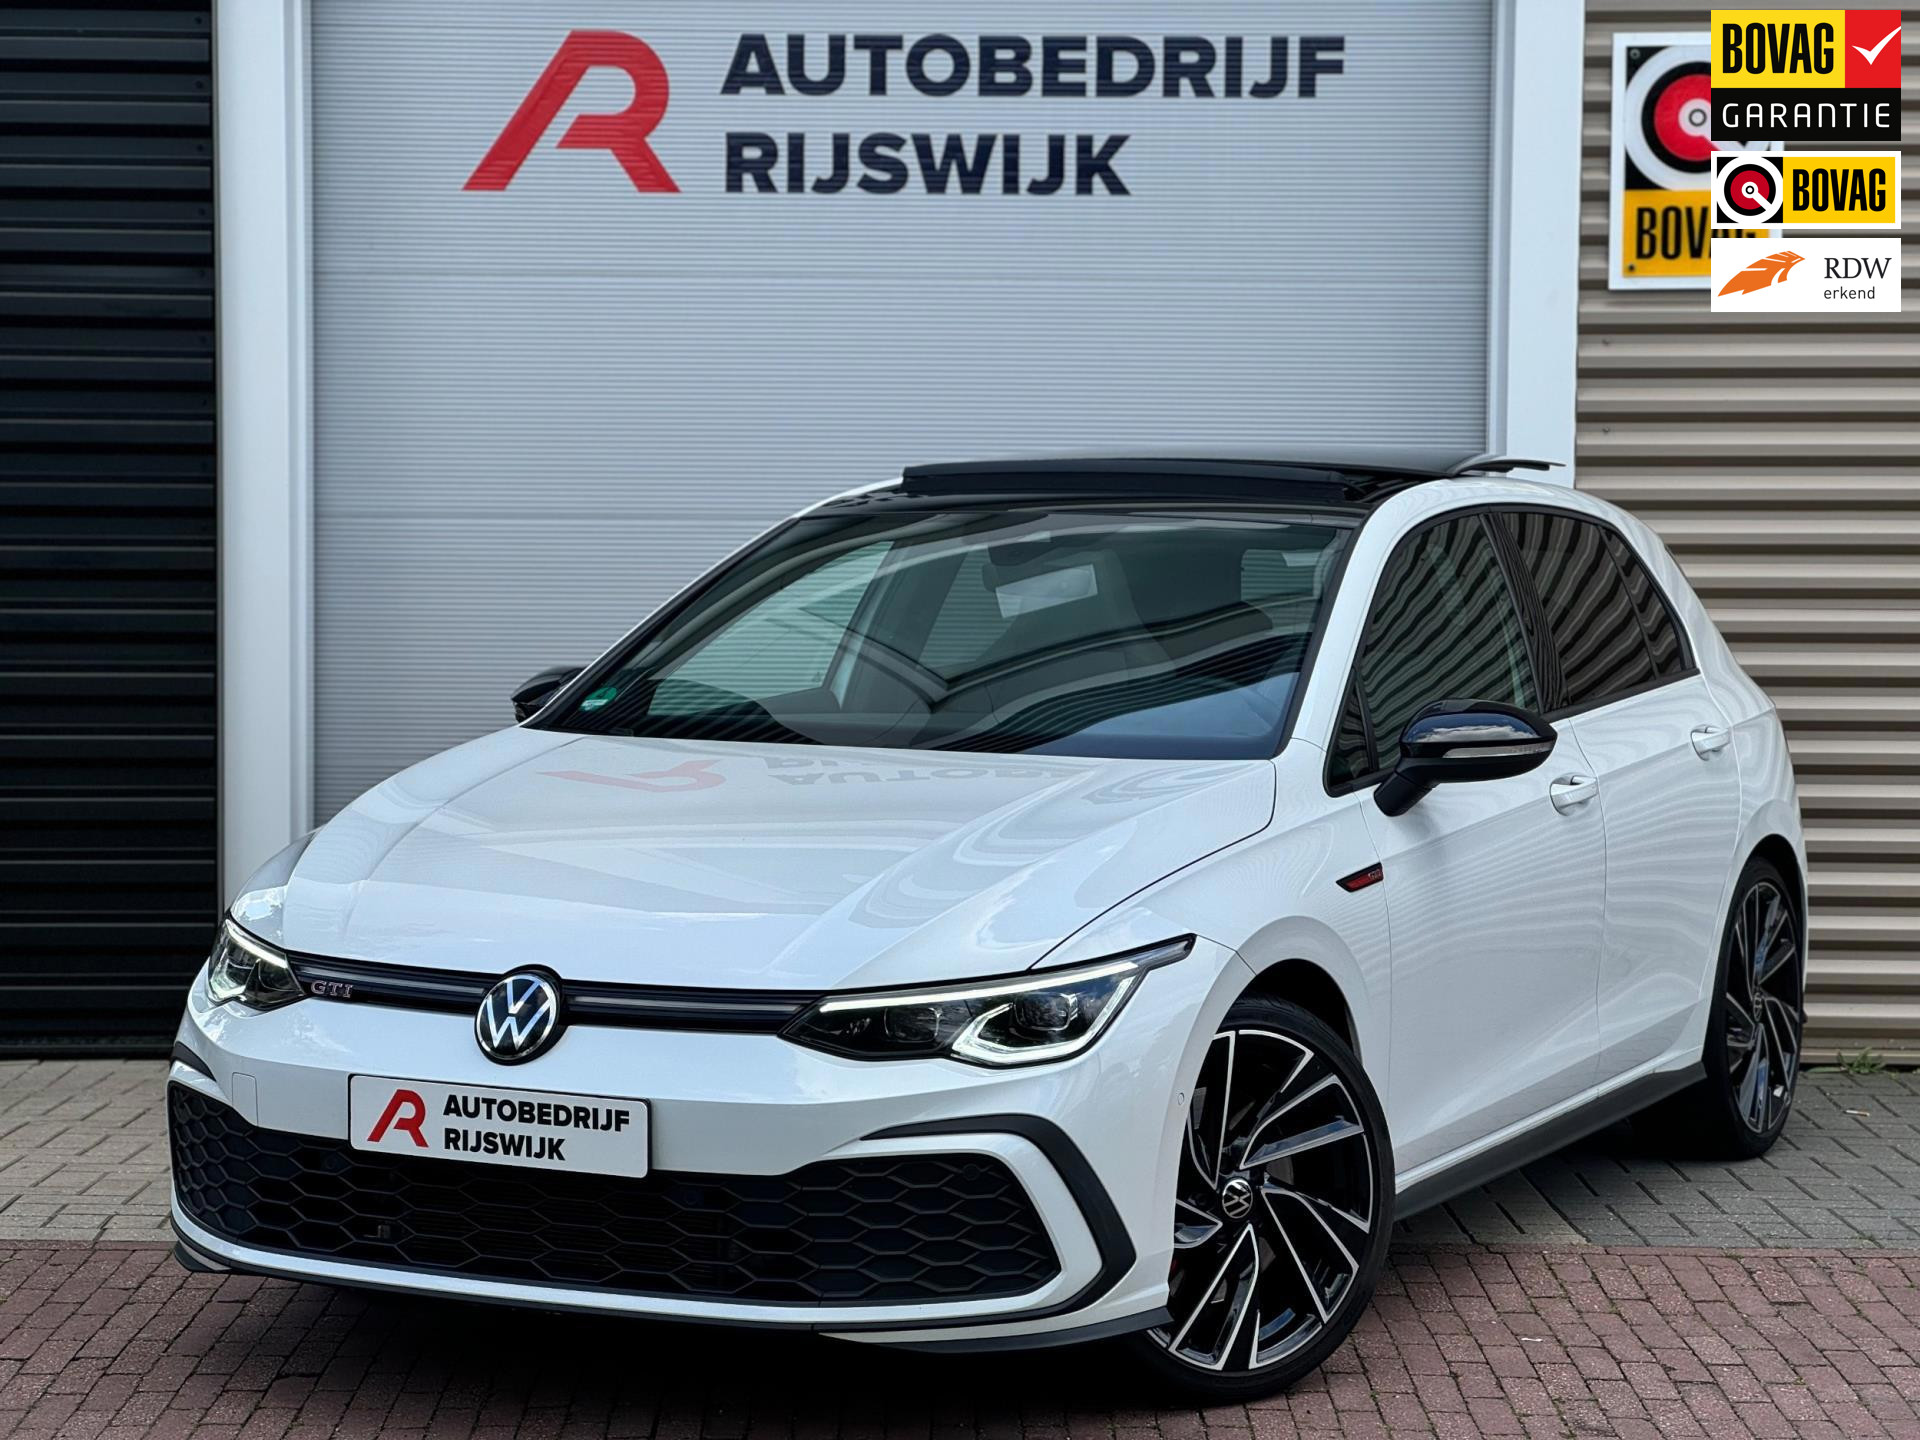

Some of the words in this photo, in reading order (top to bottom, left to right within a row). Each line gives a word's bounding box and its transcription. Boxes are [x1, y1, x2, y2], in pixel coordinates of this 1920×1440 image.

[720, 33, 1346, 99] AUTOBEDRIJF
[724, 132, 1131, 196] RIJSWIJK
[1636, 205, 1756, 260] BOV
[310, 980, 354, 998] GTI
[443, 1094, 630, 1132] AUTOBEDRIJF
[444, 1127, 565, 1161] RIJSWIJK
